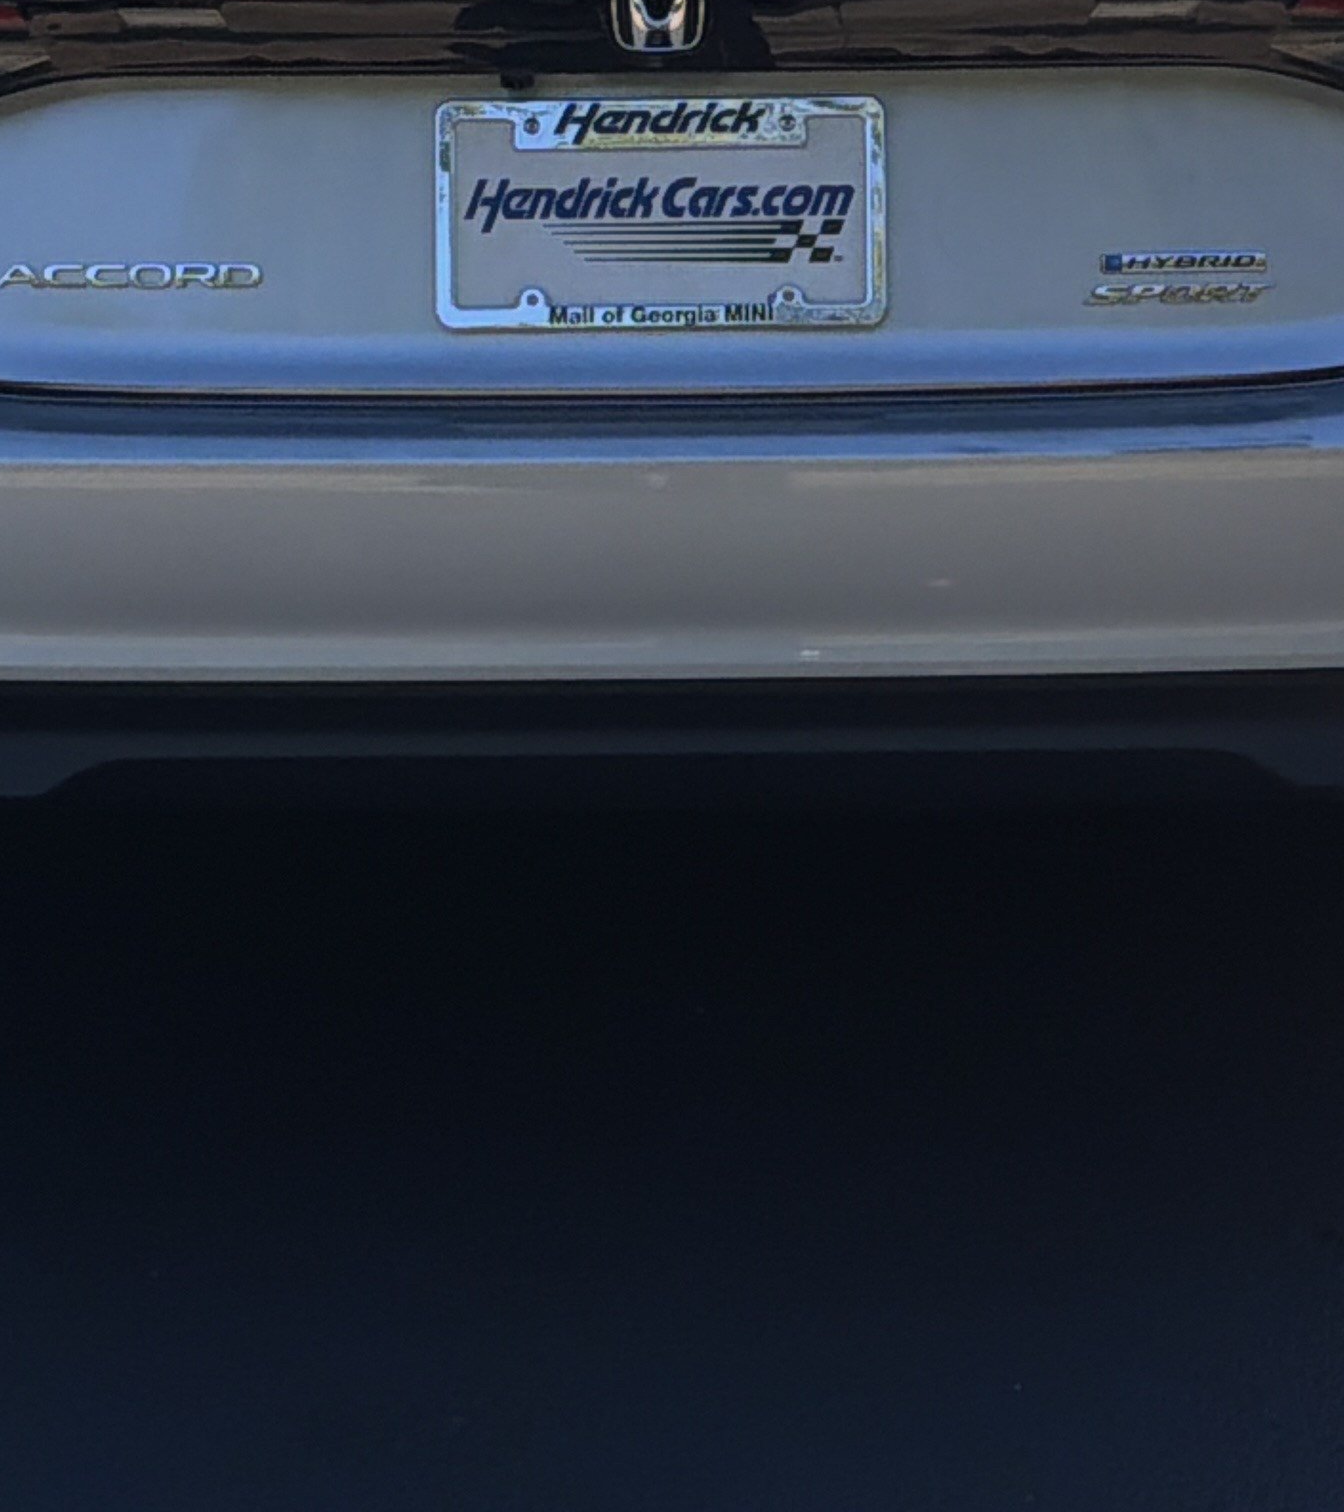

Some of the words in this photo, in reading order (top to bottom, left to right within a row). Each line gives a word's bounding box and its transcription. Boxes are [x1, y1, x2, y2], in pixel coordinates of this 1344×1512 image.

[554, 101, 767, 145] Hendrick
[463, 176, 856, 234] HendrickCars.com
[1125, 254, 1258, 271] HYBRID
[1082, 282, 1276, 306] SPORT
[549, 305, 595, 325] Mall
[601, 305, 624, 324] of
[630, 304, 716, 326] Georgia
[724, 302, 775, 322] MINI
